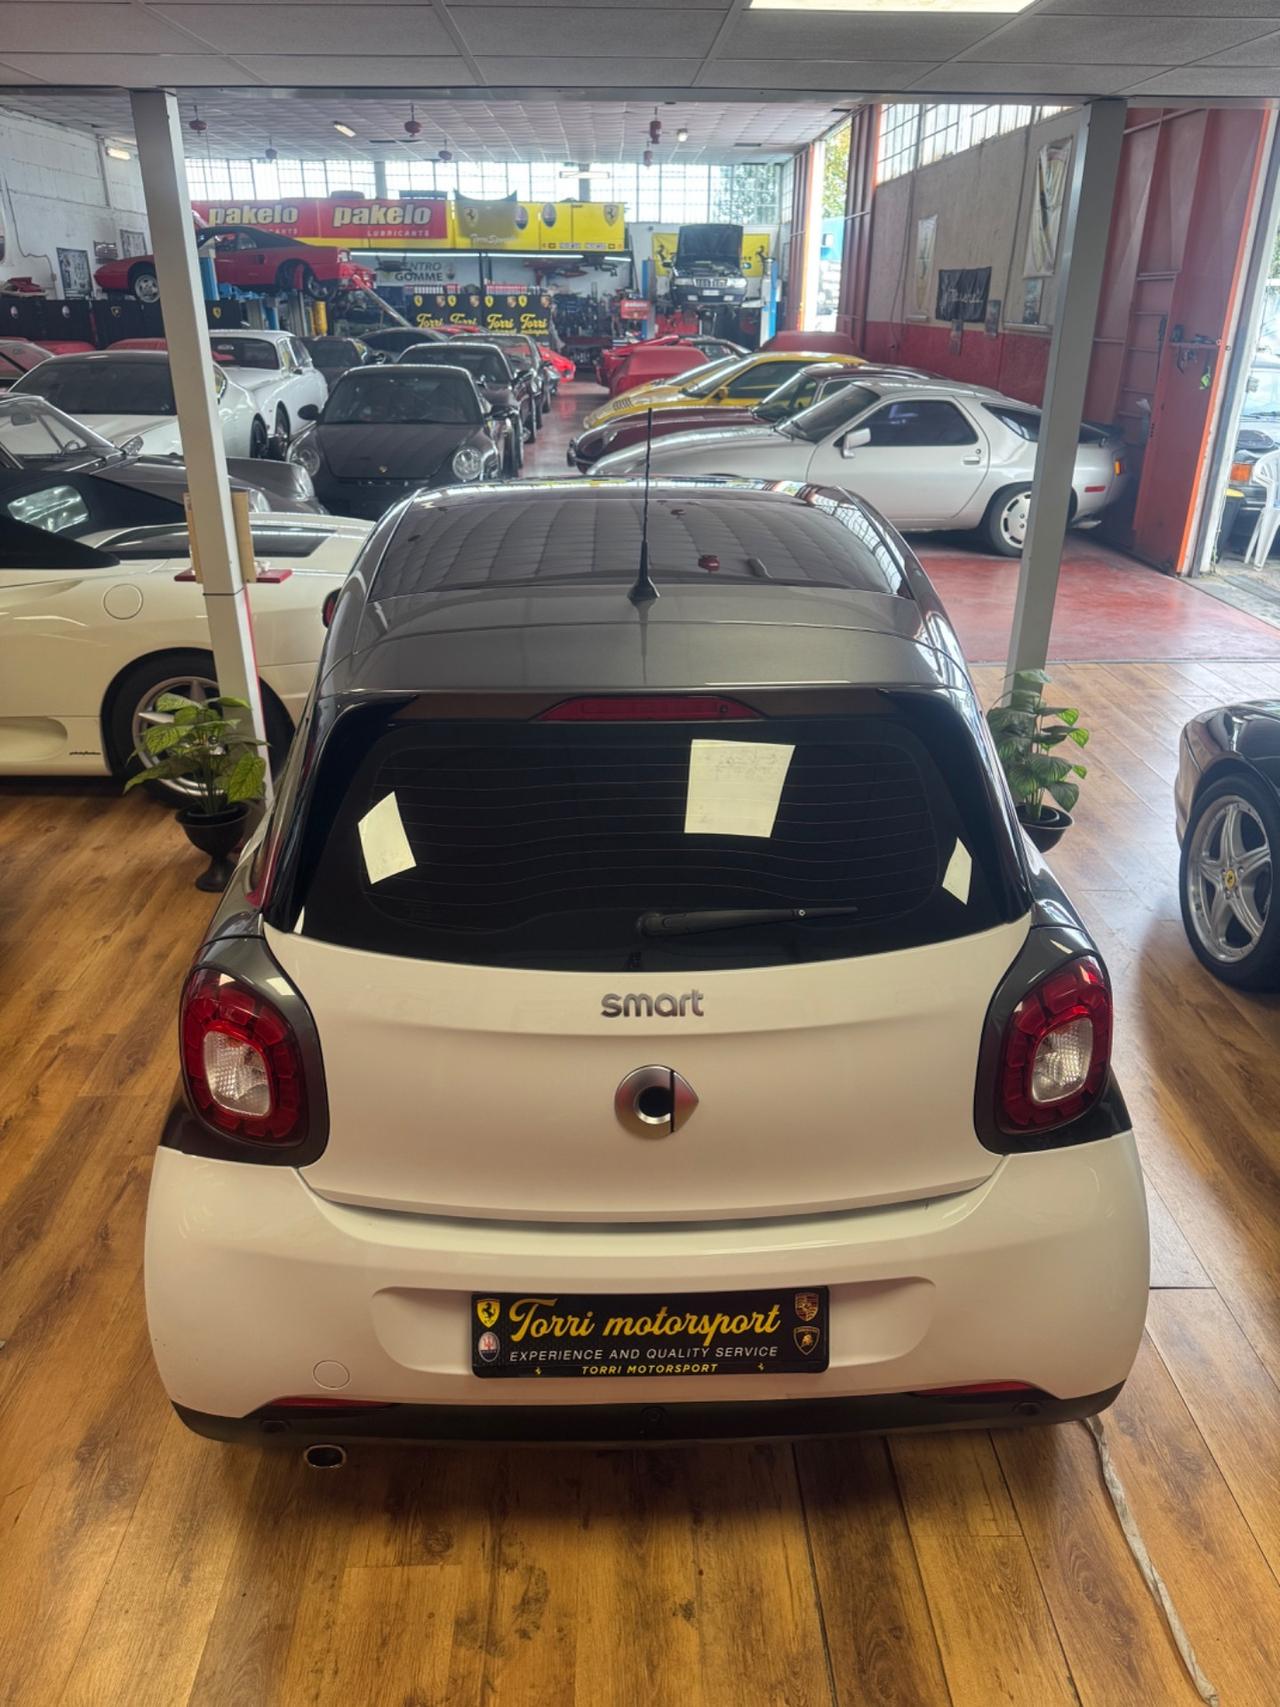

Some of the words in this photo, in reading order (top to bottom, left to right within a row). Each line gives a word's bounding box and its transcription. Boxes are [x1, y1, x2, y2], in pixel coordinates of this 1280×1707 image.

[208, 204, 299, 226] pakelo
[332, 203, 432, 228] pakelo
[367, 229, 430, 237] LUBRICANTS
[394, 272, 443, 281] GOMME
[601, 989, 705, 1018] smart
[508, 1298, 595, 1342] Torri
[602, 1304, 781, 1347] motorsport
[509, 1349, 603, 1362] EXPERIENCE
[608, 1348, 640, 1360] AND
[646, 1347, 712, 1359] QUALITY
[715, 1346, 778, 1358] SERVICE
[582, 1365, 622, 1375] TORRI
[627, 1363, 718, 1374] MOTORSPORT
